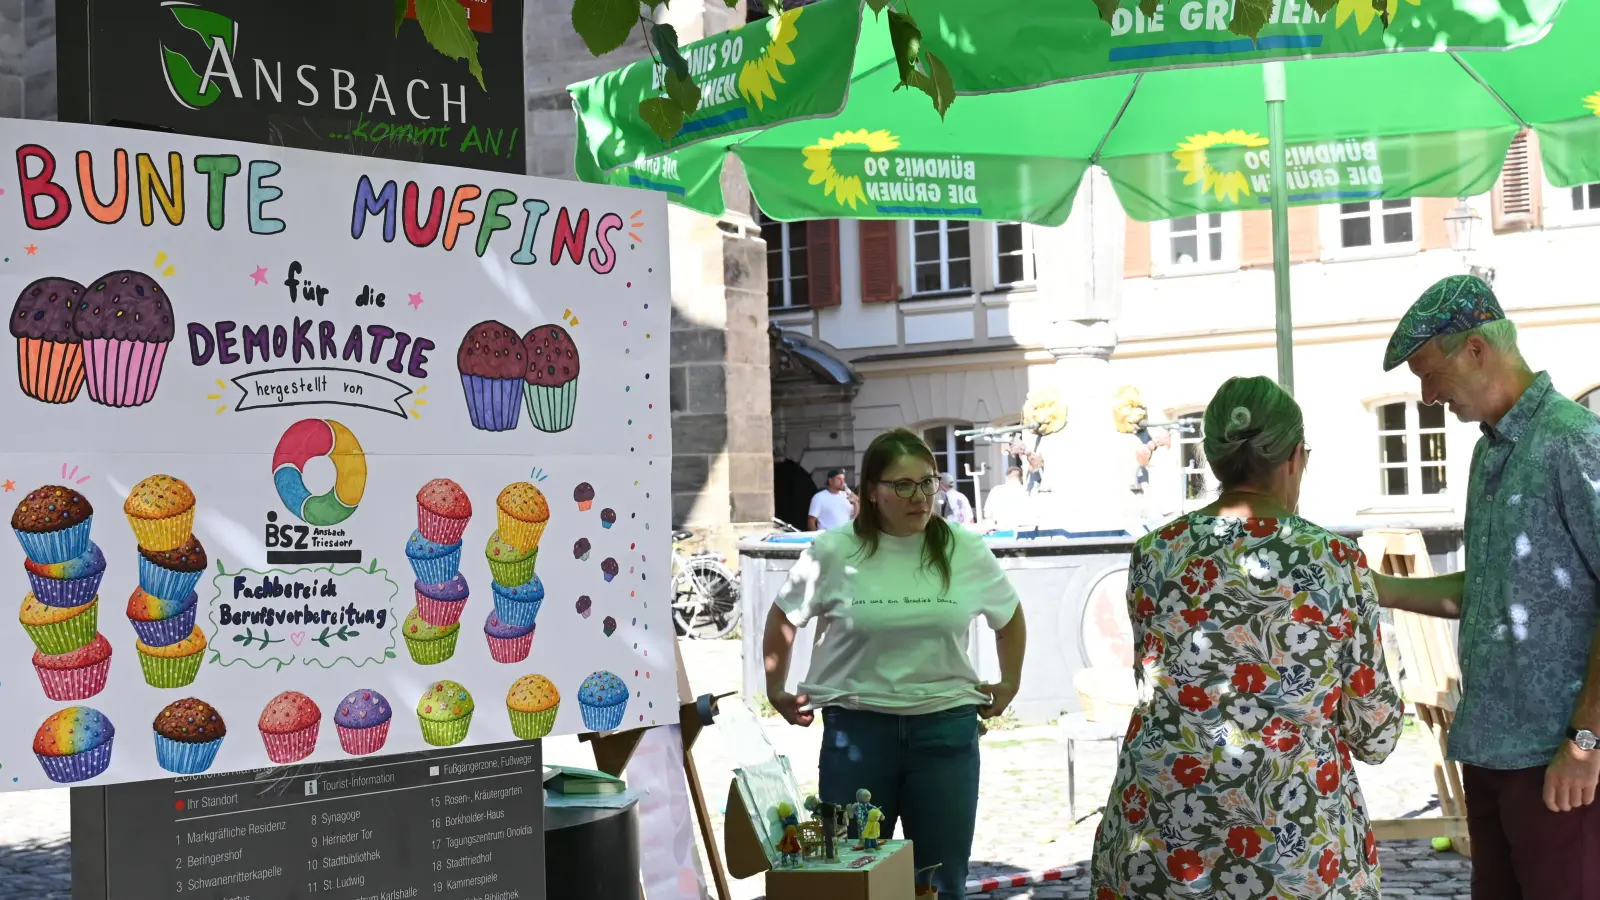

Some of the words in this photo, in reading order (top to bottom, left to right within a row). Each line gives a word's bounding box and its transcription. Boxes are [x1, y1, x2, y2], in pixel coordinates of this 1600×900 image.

[1111, 4, 1164, 36] DIE
[721, 36, 743, 68] 90
[199, 36, 468, 124] ANSBACH
[460, 124, 518, 158] AN!
[15, 143, 286, 235] BUNTE
[350, 174, 624, 275] MUFFINS
[283, 260, 329, 306] für
[355, 284, 386, 308] die
[187, 315, 436, 378] DEMOKRATIE
[255, 374, 328, 402] hergestellt
[343, 379, 363, 396] von
[311, 536, 353, 548] Triesdorf
[313, 527, 346, 537] Ansbach
[233, 575, 337, 600] Fachbereich
[219, 602, 387, 629] Berufsvorbereitung
[443, 759, 500, 776] Fußgängerzone,
[500, 755, 532, 767] Fußwege
[322, 772, 395, 791] Tourist-Information
[187, 799, 199, 810] Ihr
[201, 793, 238, 808] Standort
[430, 797, 441, 807] 15
[474, 786, 523, 801] Kräutergarten
[311, 815, 317, 825] 8
[321, 810, 361, 825] Synagoge
[431, 818, 441, 829] 16
[445, 809, 505, 827] Borkholder-Haus
[175, 834, 180, 845] 1
[187, 826, 246, 844] Markgräfliche
[248, 820, 286, 835] Residenz
[311, 837, 318, 848] 9
[322, 832, 359, 846] Herrieder
[361, 828, 373, 840] Tor
[431, 839, 441, 850] 17
[445, 830, 505, 849] Tagungszentrum
[506, 825, 533, 838] Onoldia
[175, 858, 182, 869] 2
[187, 848, 243, 868] Beringershof
[307, 859, 318, 871] 10
[322, 849, 381, 868] Stadtbibliothek
[432, 861, 442, 871] 18
[446, 852, 493, 869] Stadtfriedhof
[176, 881, 183, 893] 3
[188, 865, 282, 891] Schwanenritterkapelle
[308, 882, 317, 892] 11
[323, 879, 334, 891] St.
[336, 874, 365, 888] Ludwig
[433, 882, 443, 892] 19
[446, 872, 498, 890] Kammerspiele
[380, 886, 418, 900] Karlshalle
